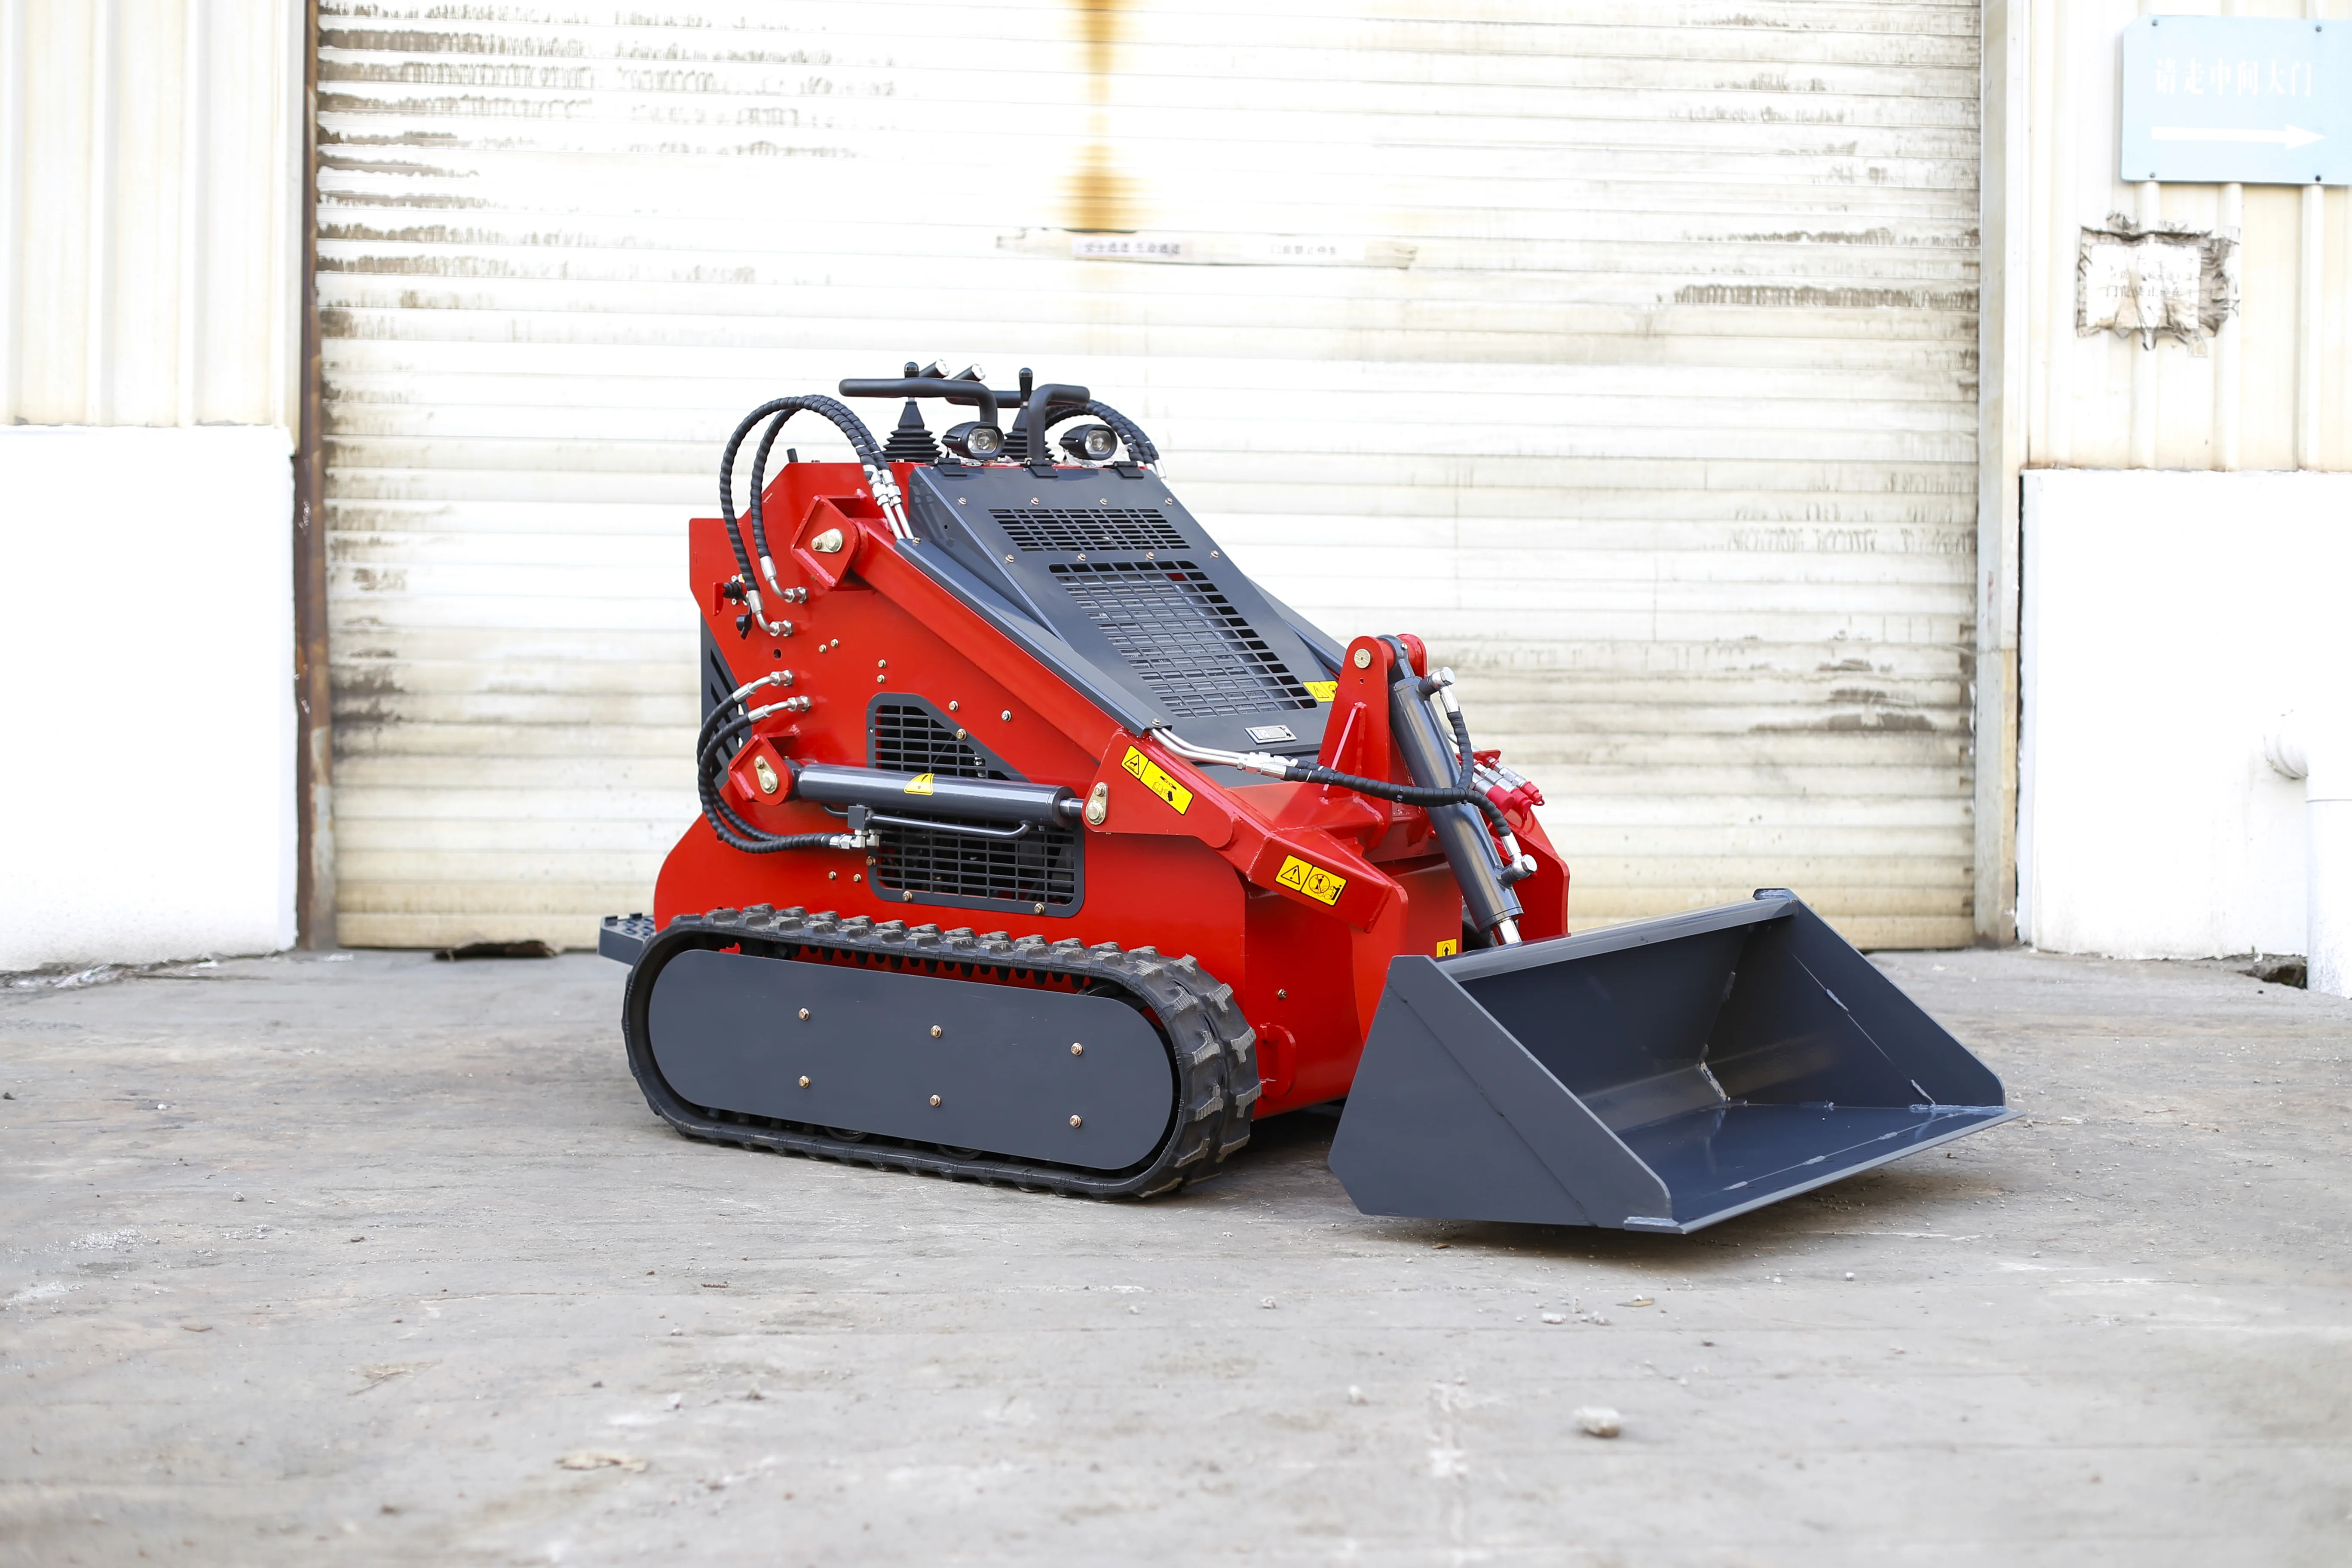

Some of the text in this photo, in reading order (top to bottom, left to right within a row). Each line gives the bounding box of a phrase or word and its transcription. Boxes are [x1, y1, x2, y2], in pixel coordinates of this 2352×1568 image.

[2155, 57, 2312, 97] 请走中间大门
